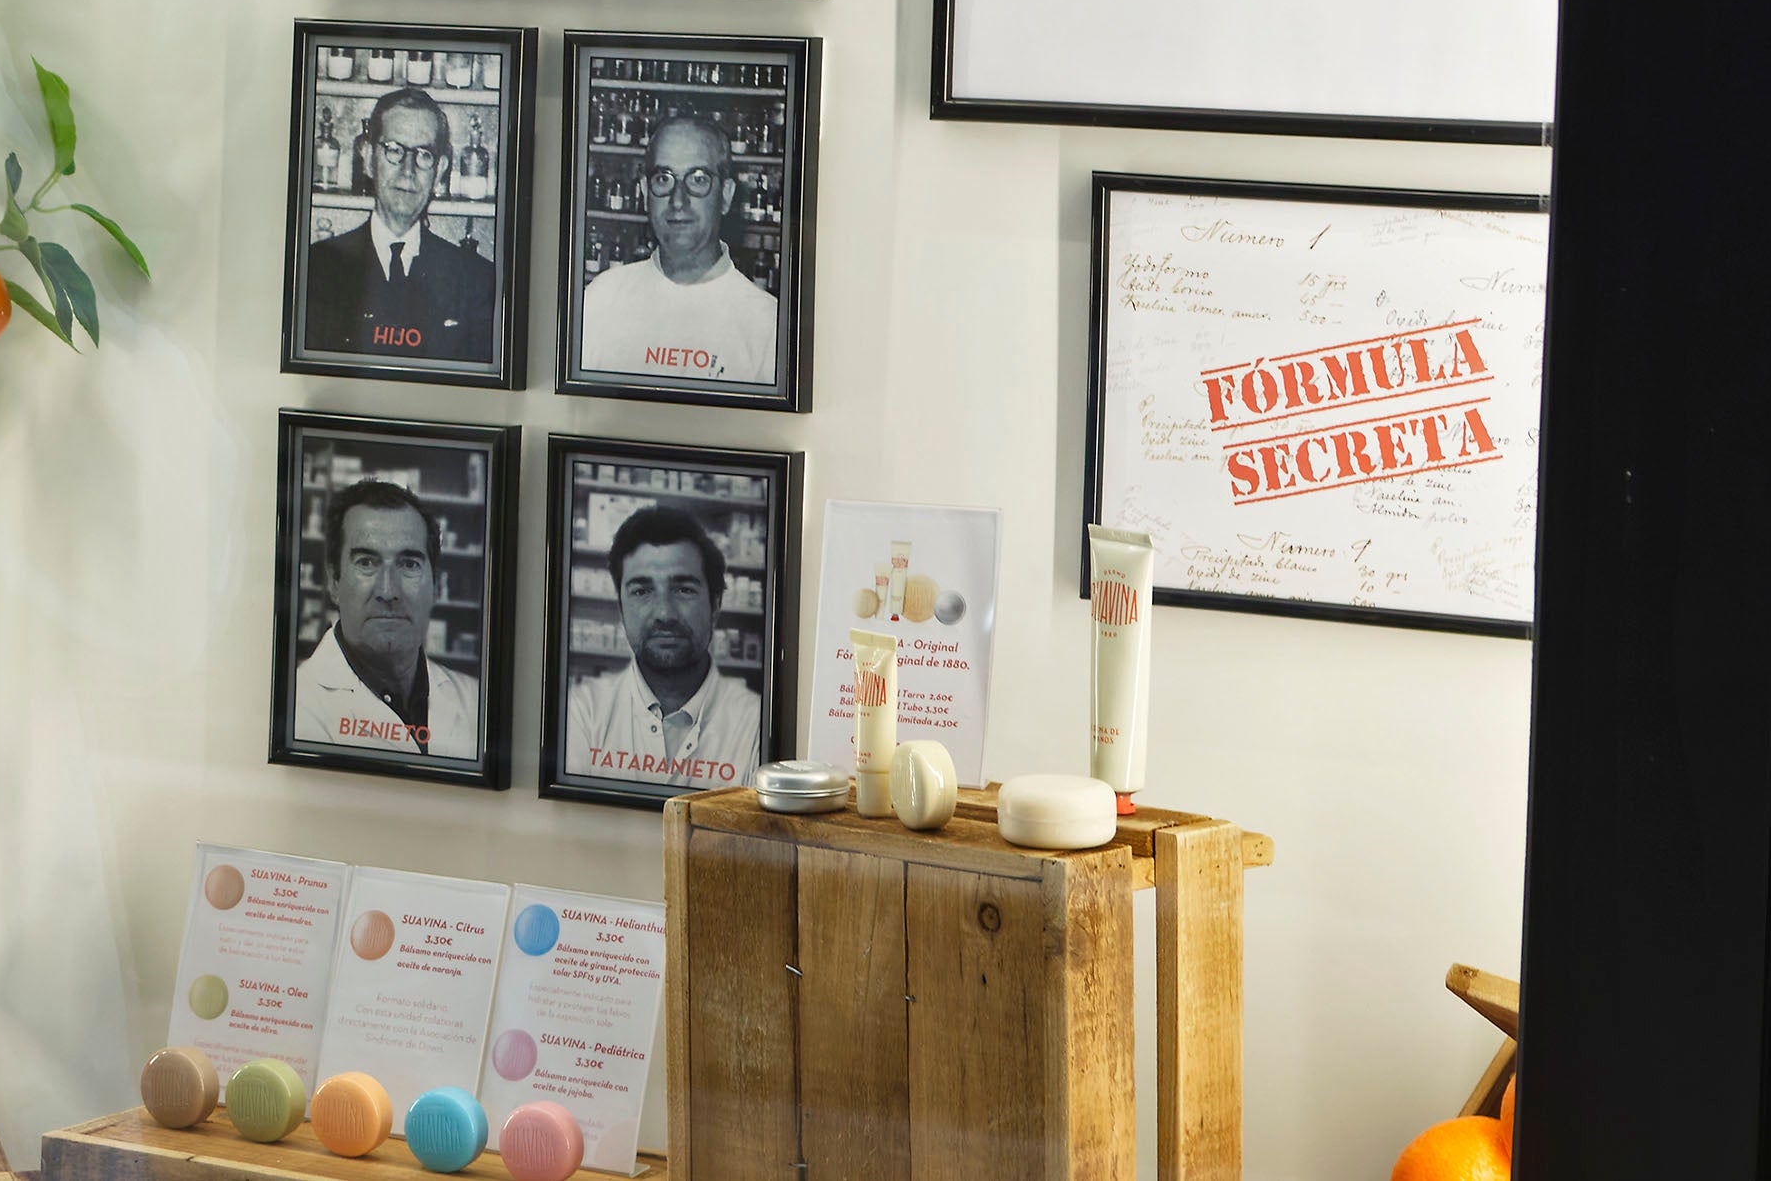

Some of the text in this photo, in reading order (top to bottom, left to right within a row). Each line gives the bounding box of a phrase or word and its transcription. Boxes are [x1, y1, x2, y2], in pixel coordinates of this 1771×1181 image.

[373, 325, 422, 348] HIJO
[645, 346, 710, 368] NIETO
[1202, 327, 1489, 423] FÓRMULA
[1226, 407, 1498, 499] SECRETA
[913, 639, 959, 654] Original
[897, 655, 970, 670] ginal de 1880.
[903, 690, 926, 700] Tarro
[828, 709, 854, 719] Bálsa
[897, 715, 932, 726] limitada
[903, 702, 923, 713] Tubo
[339, 717, 431, 744] BIZNIETO
[589, 747, 736, 782] TATARANIETO
[250, 868, 328, 889] SUAVINA Prunus
[401, 914, 485, 935] SUAVINA Citrus
[561, 909, 607, 925] SUAVINA
[399, 944, 492, 965] Bálsamo enriquecido con
[556, 943, 650, 965] Bálsamo enriquecido con
[397, 960, 420, 971] aceite
[421, 963, 431, 972] de
[553, 969, 571, 978] solar
[572, 970, 594, 982] SPF15
[595, 976, 601, 984] y
[554, 956, 578, 967] aceite
[579, 958, 589, 968] de
[618, 966, 661, 980] protección
[239, 979, 309, 999] SUAVINA Olea
[540, 1033, 646, 1060] SUAVINA Pediátrica
[532, 1082, 557, 1092] aceite
[557, 1085, 567, 1095] de
[534, 1068, 629, 1092] Bálsamo enriquecido con
